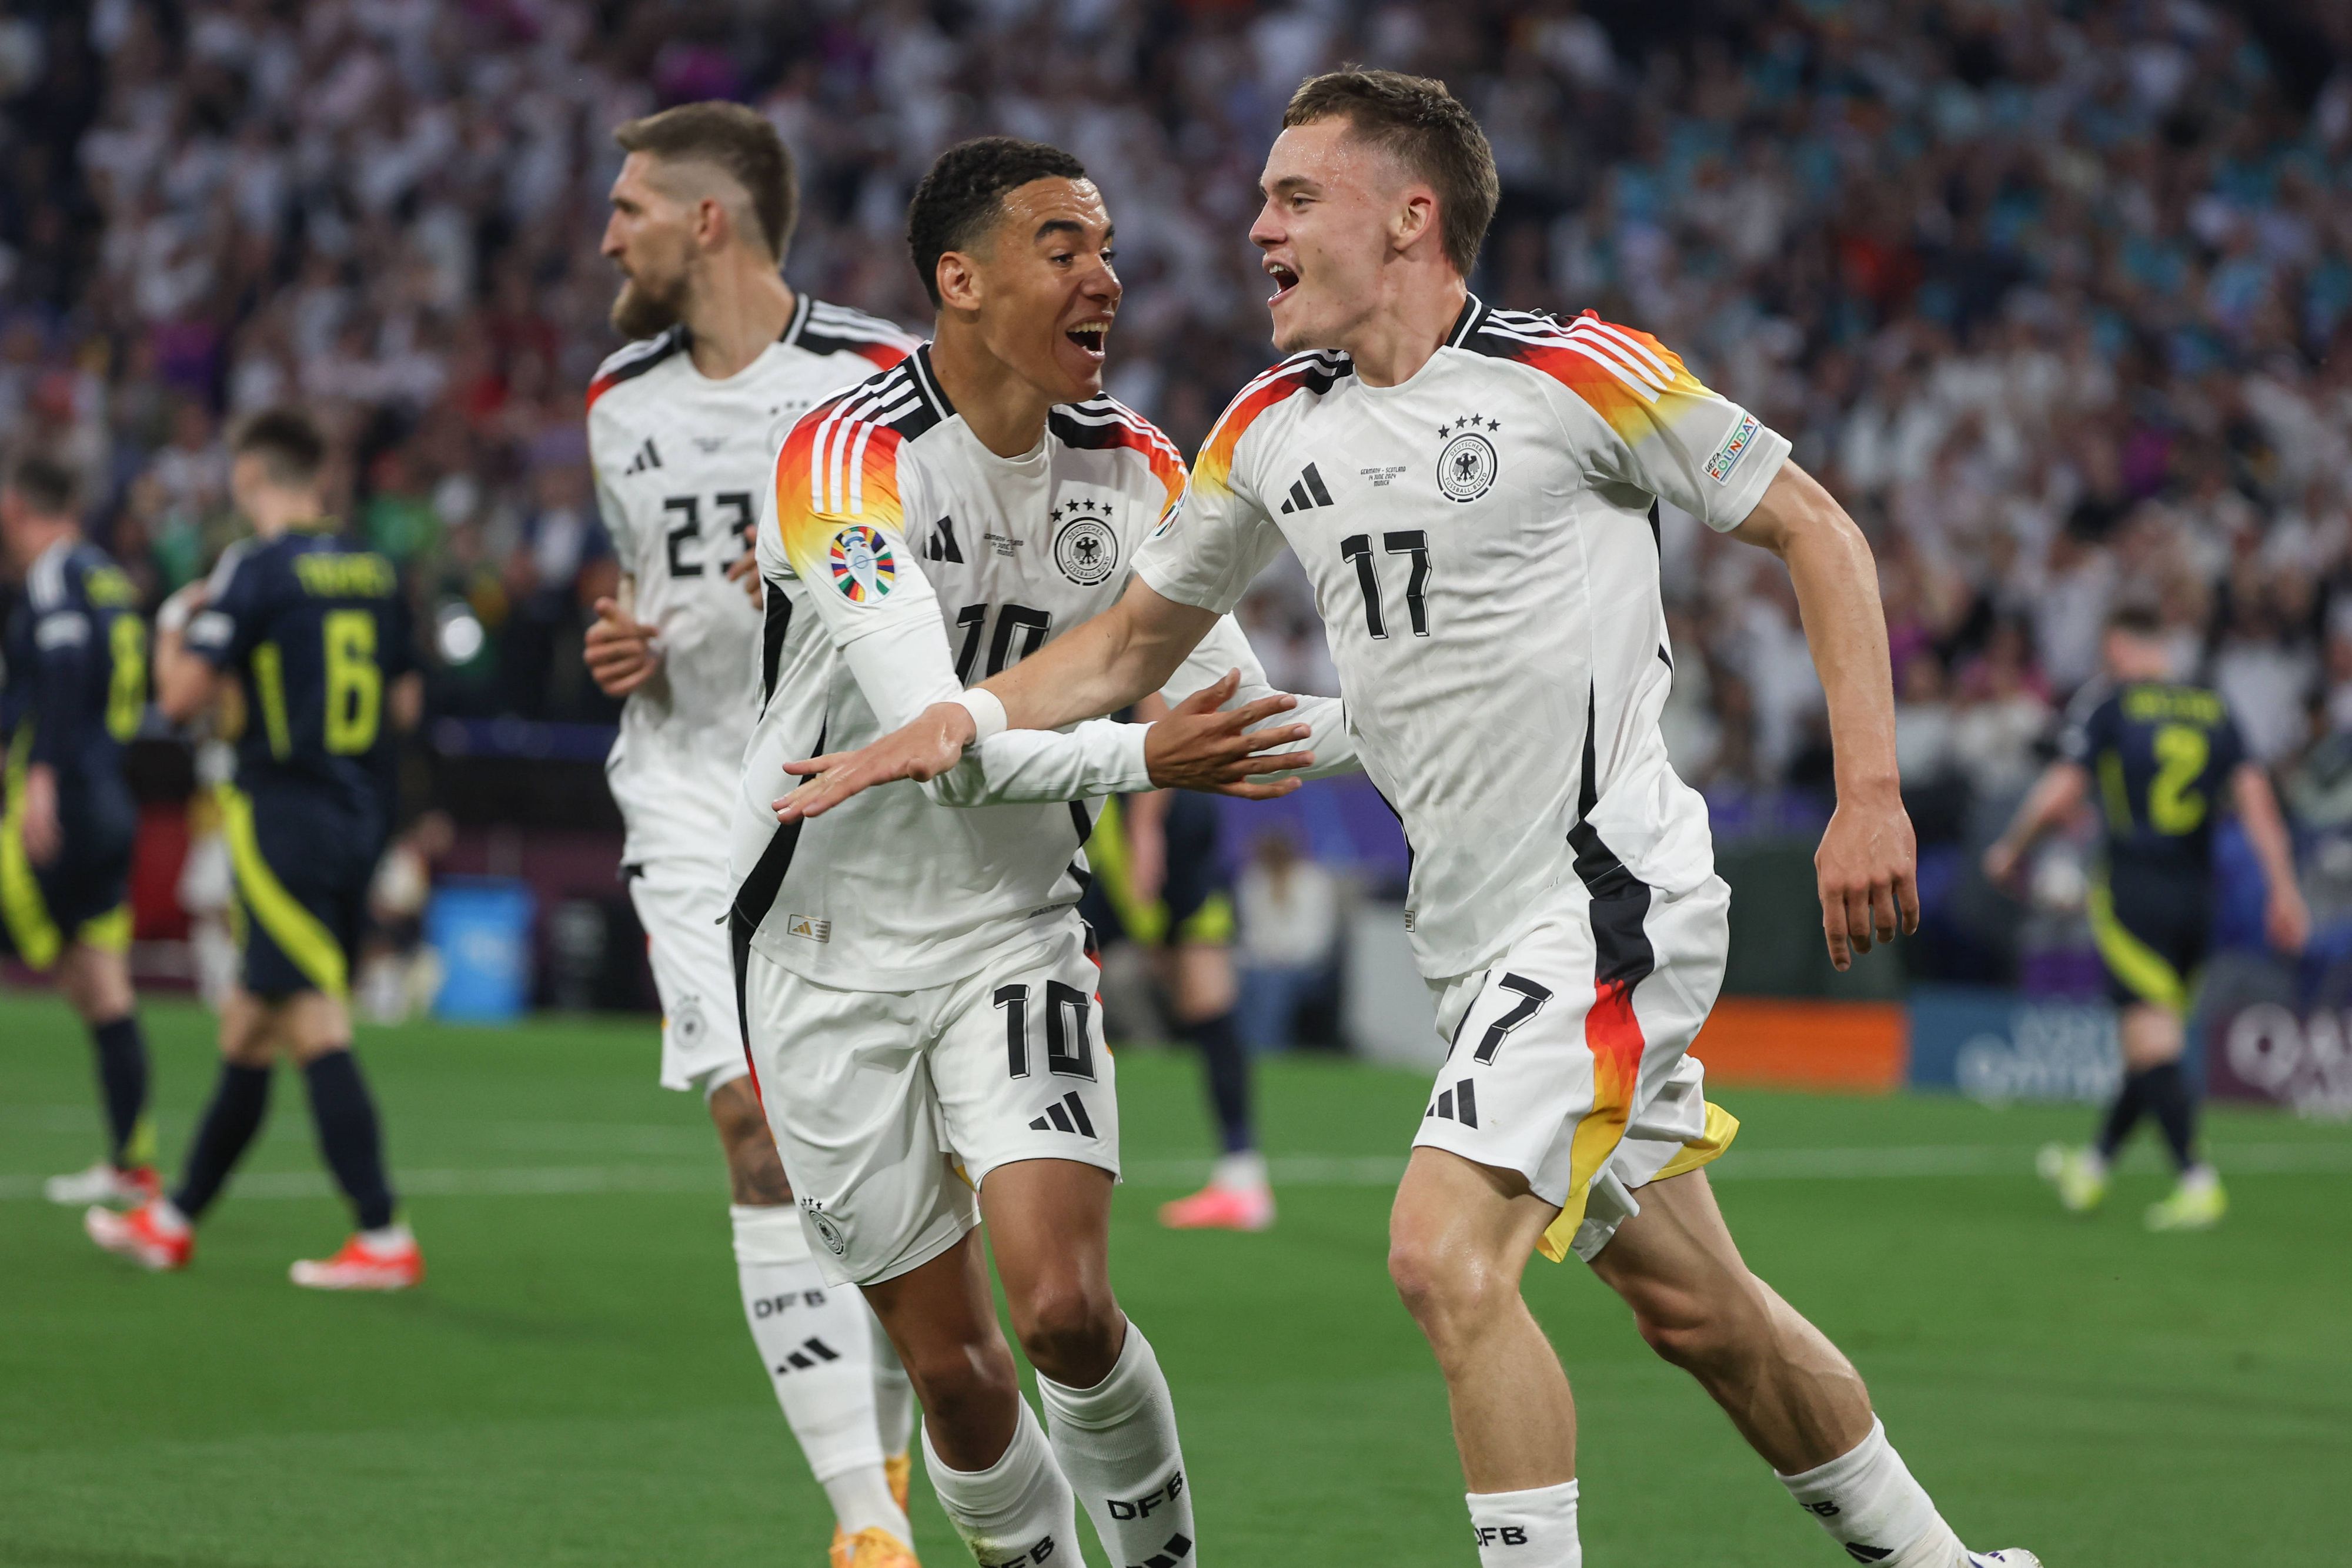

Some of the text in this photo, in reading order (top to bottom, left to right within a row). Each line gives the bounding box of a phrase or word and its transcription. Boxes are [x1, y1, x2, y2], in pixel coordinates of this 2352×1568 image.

[1445, 472, 1487, 493] FUSSBALL-BUND
[1450, 442, 1483, 456] DEUTSCHER
[1705, 452, 1721, 472] UEFA
[664, 493, 754, 576] 23
[1341, 530, 1432, 640] 17
[323, 609, 382, 755] 6
[957, 603, 1053, 687] 10
[2149, 726, 2209, 835] 2
[994, 980, 1097, 1083] 10
[754, 1289, 826, 1319] DFB
[1107, 1471, 1182, 1520] DFB
